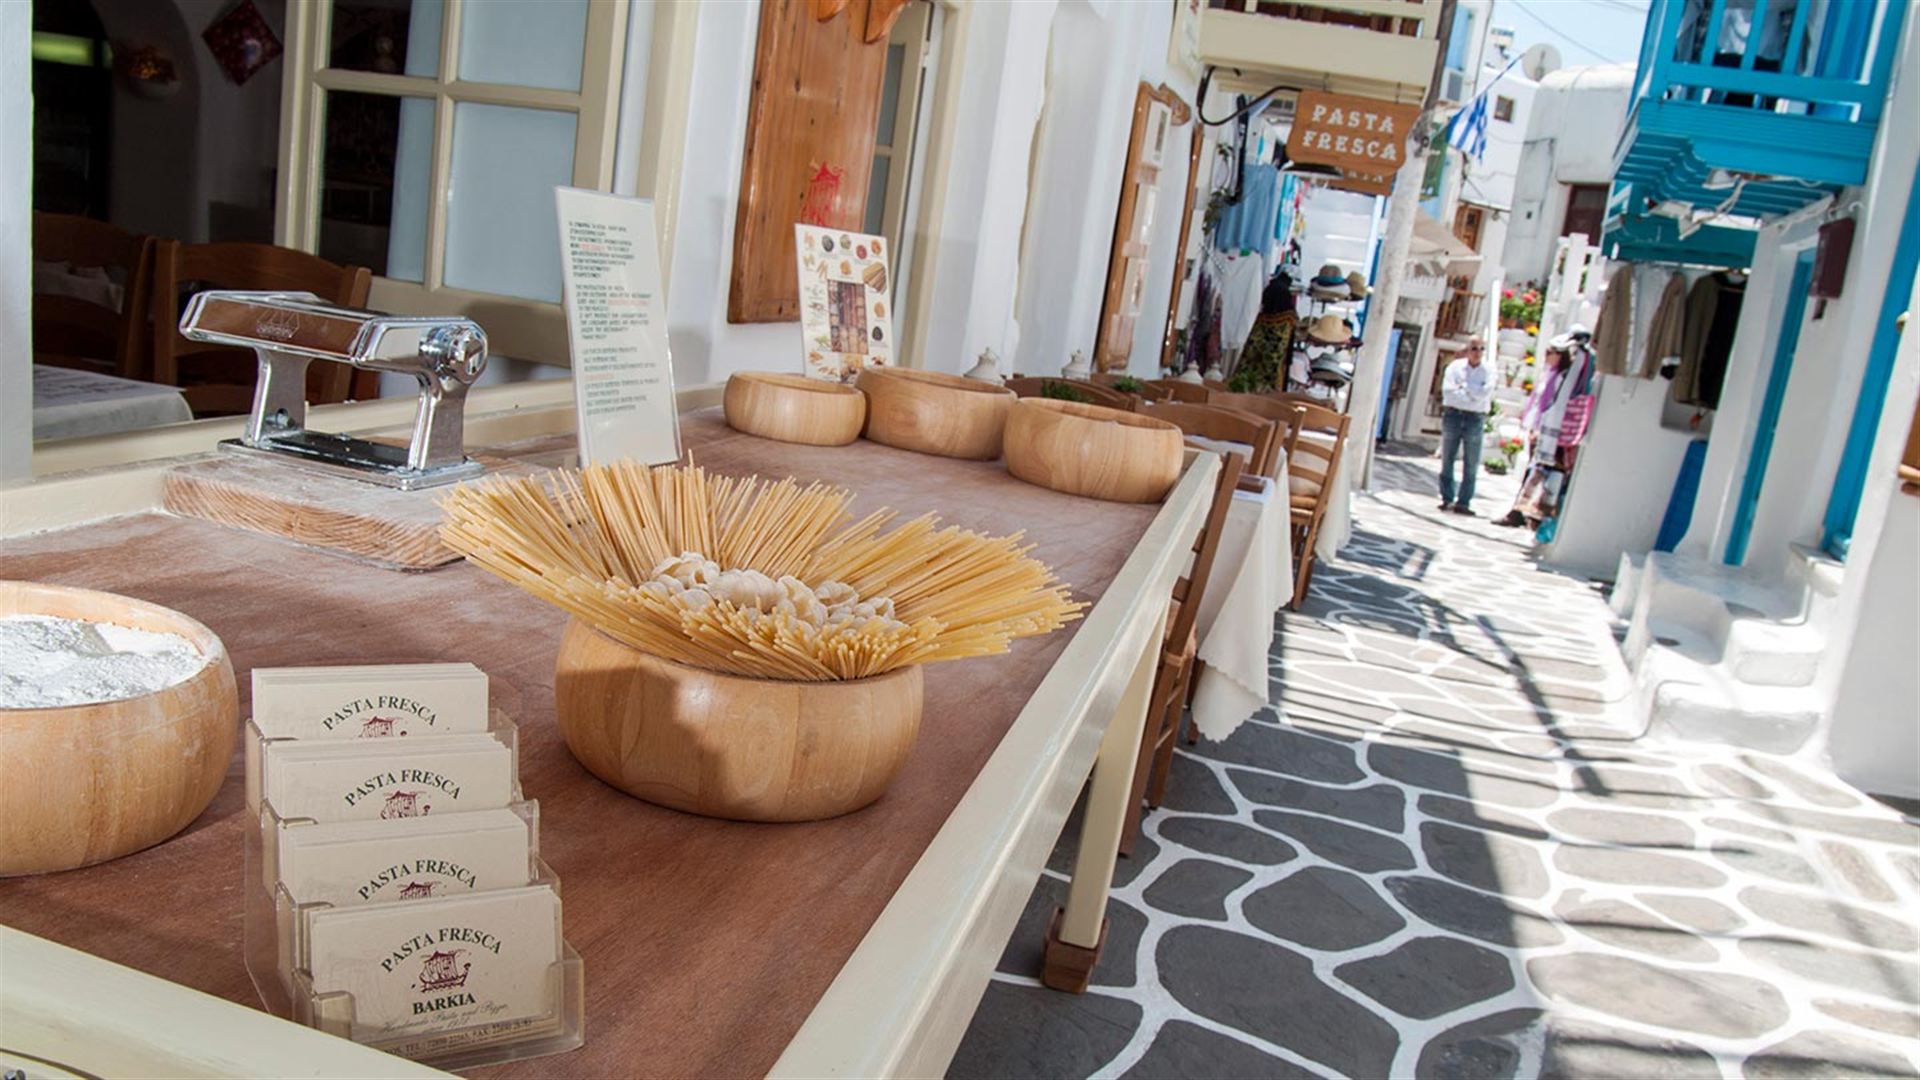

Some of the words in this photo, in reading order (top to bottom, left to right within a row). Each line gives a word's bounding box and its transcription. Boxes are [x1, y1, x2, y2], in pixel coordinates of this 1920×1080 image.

[1311, 104, 1394, 134] PASTA
[1302, 130, 1397, 161] FRESCA
[322, 698, 373, 731] PASTA
[378, 695, 437, 726] FRESCA
[344, 772, 396, 806] PASTA
[401, 769, 461, 800] FRESCA
[358, 863, 411, 899] PASTA
[415, 859, 477, 888] FRESCA
[381, 933, 434, 972] PASTA
[439, 927, 502, 954] FRESCA
[412, 992, 476, 1015] BARKIA
